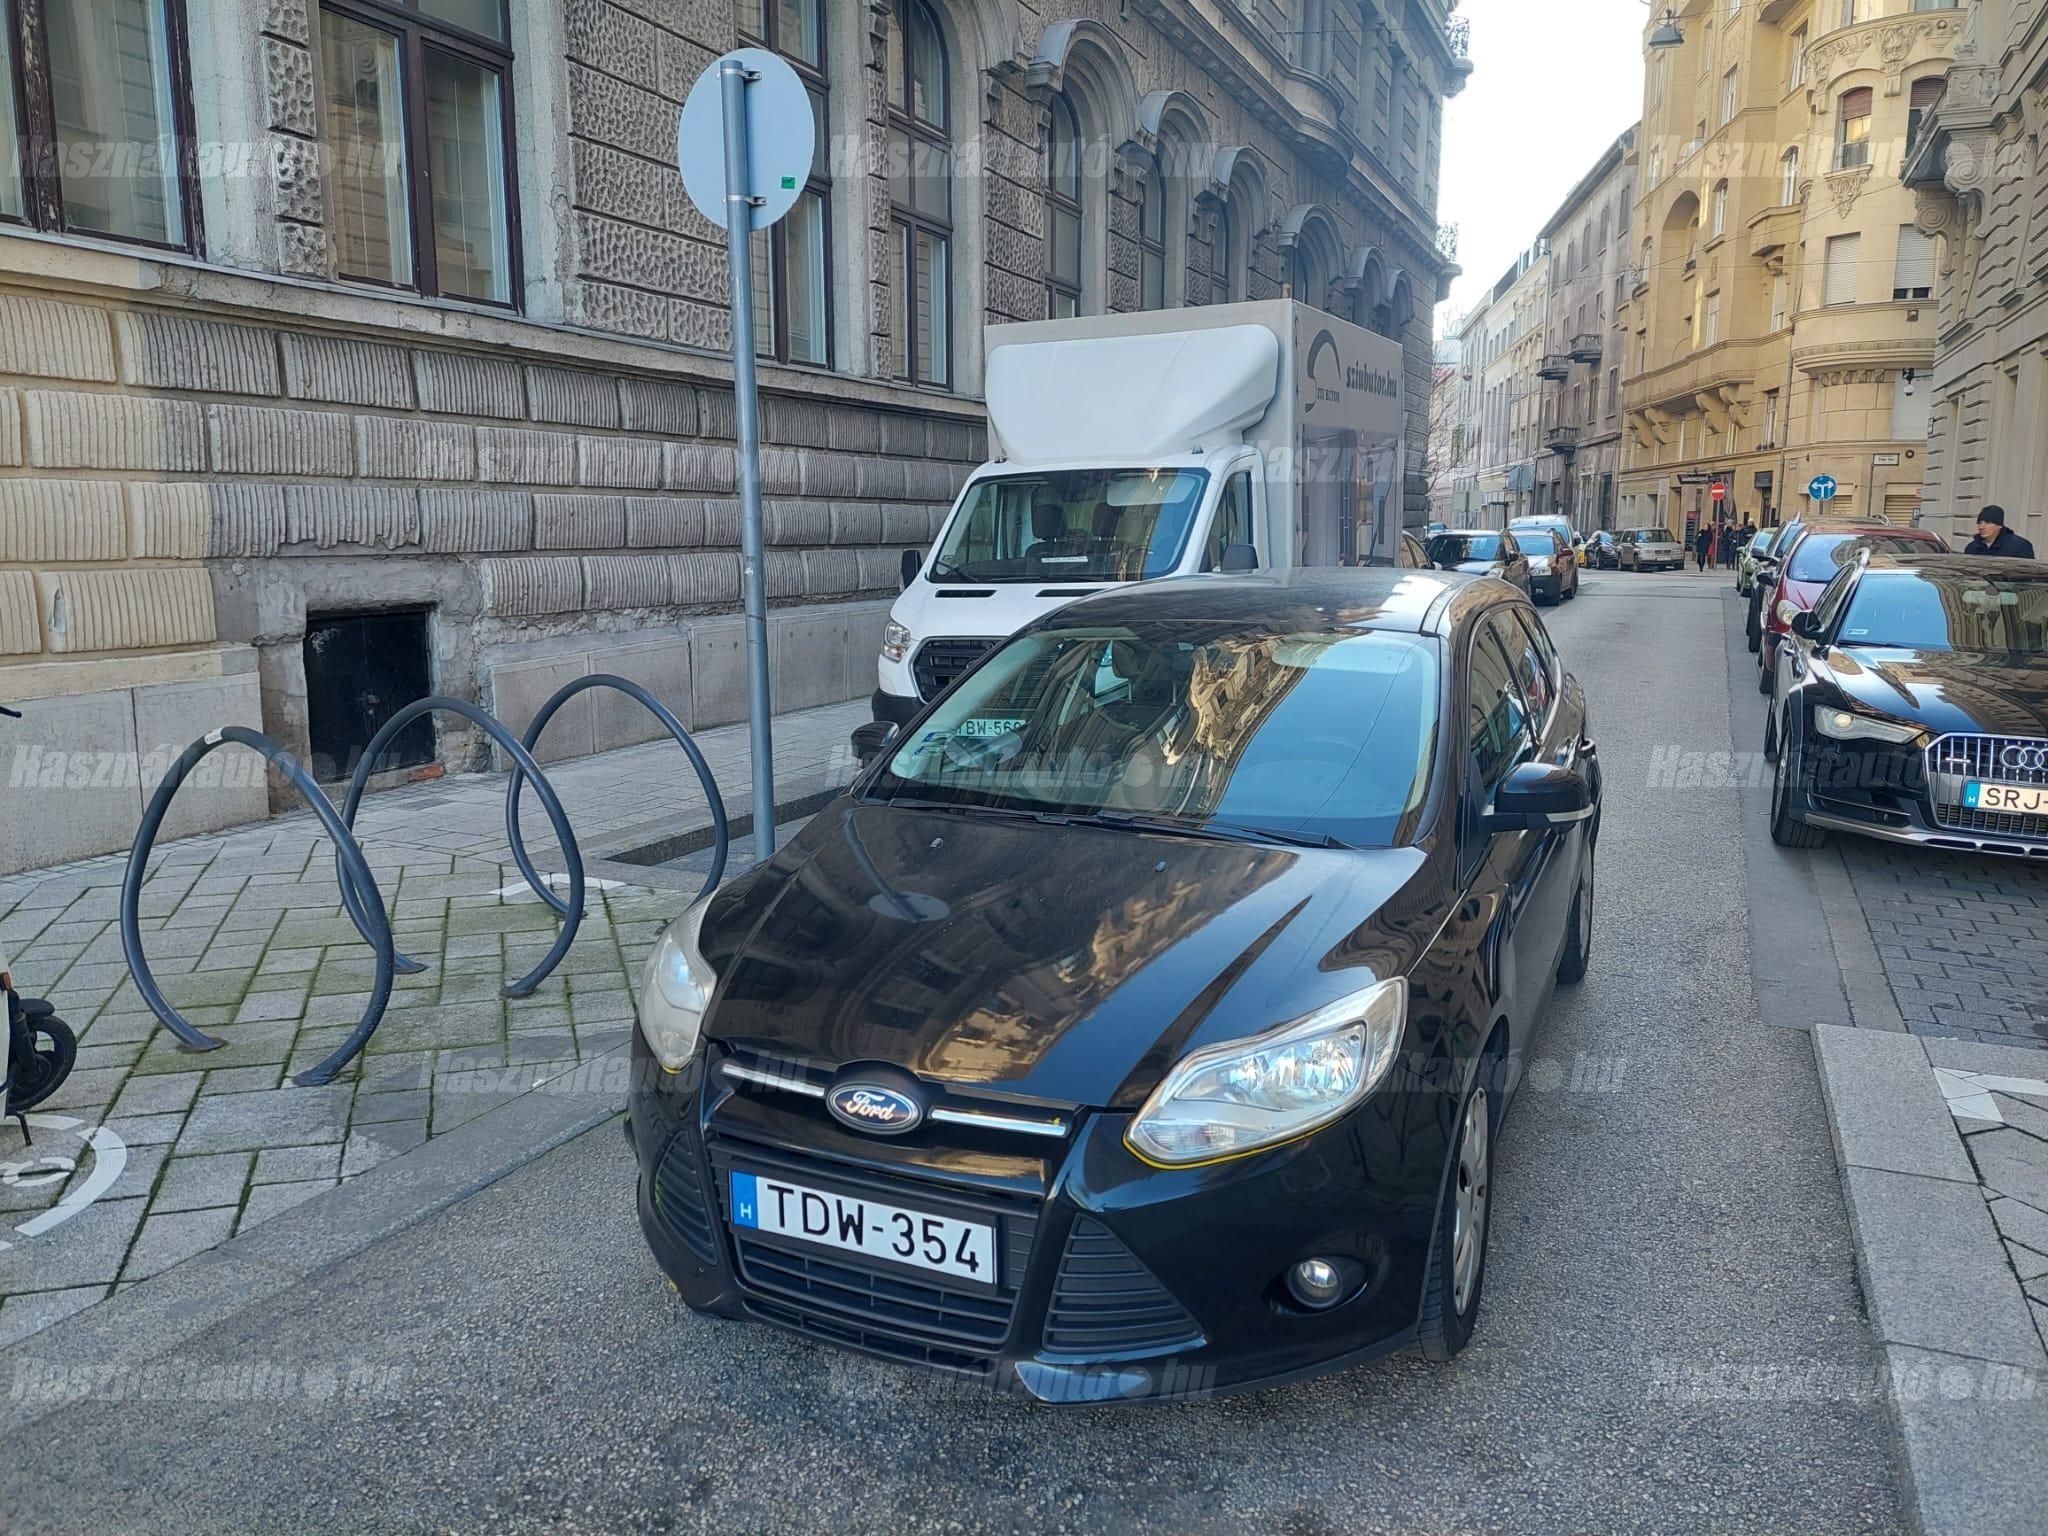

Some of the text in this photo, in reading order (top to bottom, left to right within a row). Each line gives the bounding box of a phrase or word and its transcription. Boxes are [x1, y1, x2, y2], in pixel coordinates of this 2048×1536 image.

[1345, 359, 1397, 399] sziubutor.hu
[843, 1091, 896, 1121] Ford
[740, 1202, 752, 1220] H
[767, 1184, 980, 1273] TDW-354
